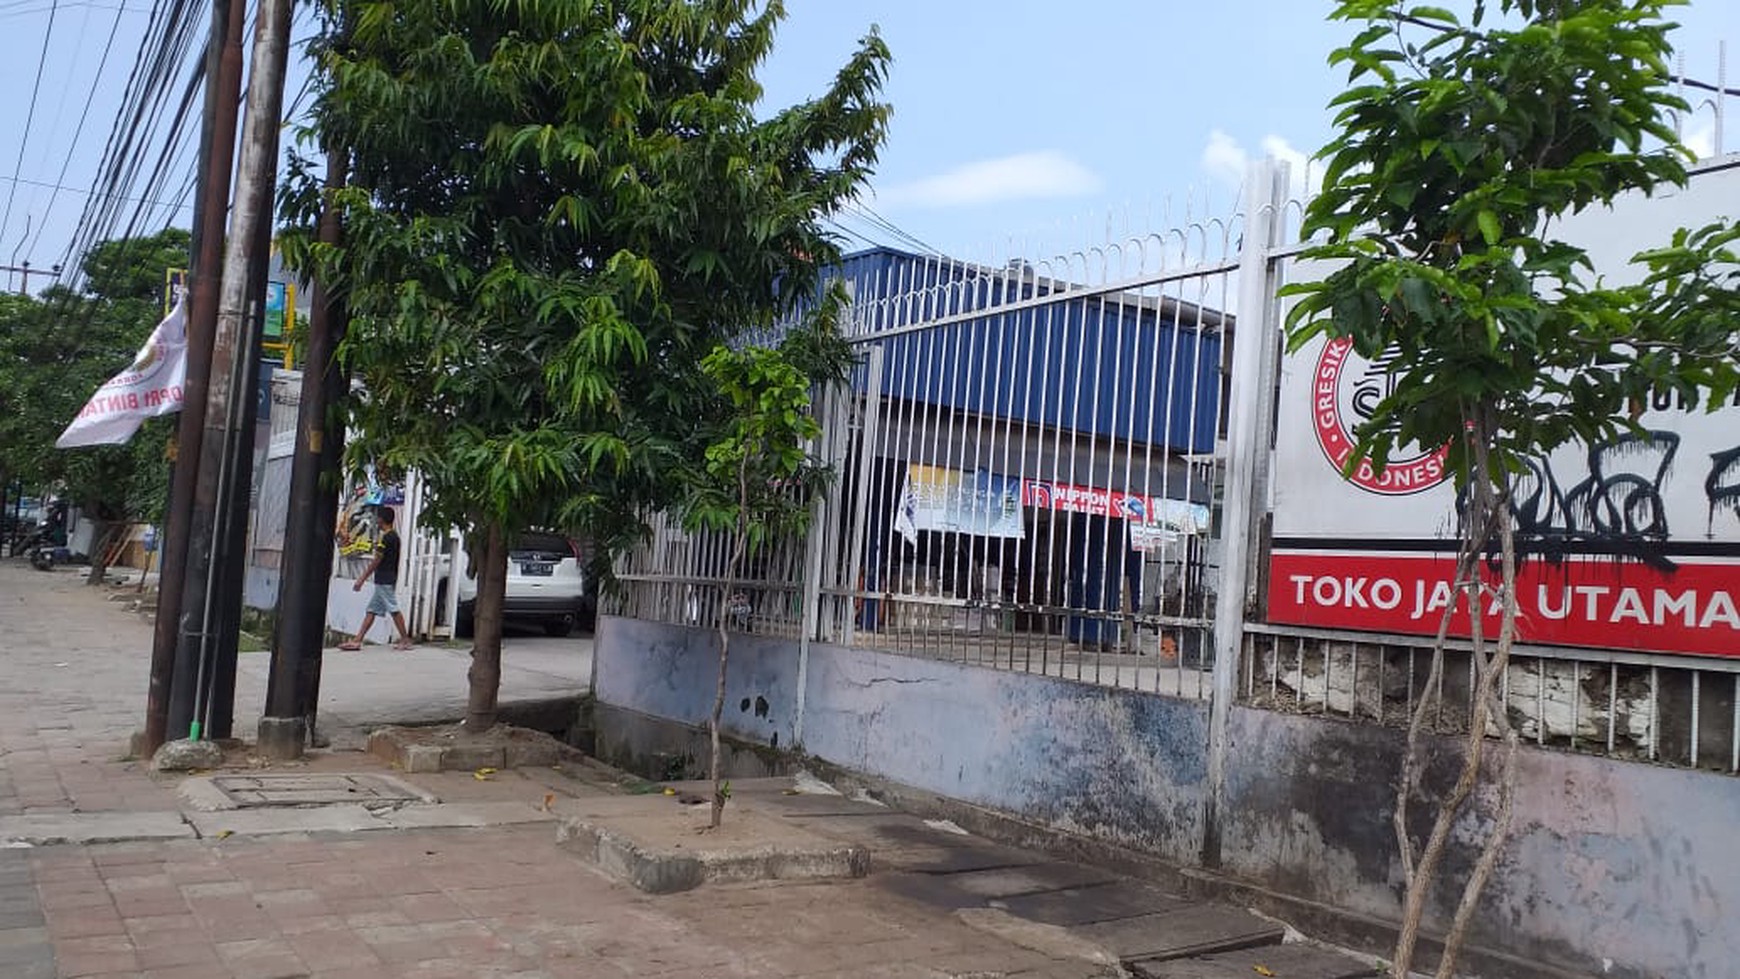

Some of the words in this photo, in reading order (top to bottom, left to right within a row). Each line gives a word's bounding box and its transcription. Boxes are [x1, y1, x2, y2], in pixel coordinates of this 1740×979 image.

[1319, 341, 1347, 429] GRESIK
[1054, 487, 1108, 506] NIPPON
[1290, 575, 1402, 610] TOKO
[1538, 584, 1740, 630] UTAMA
